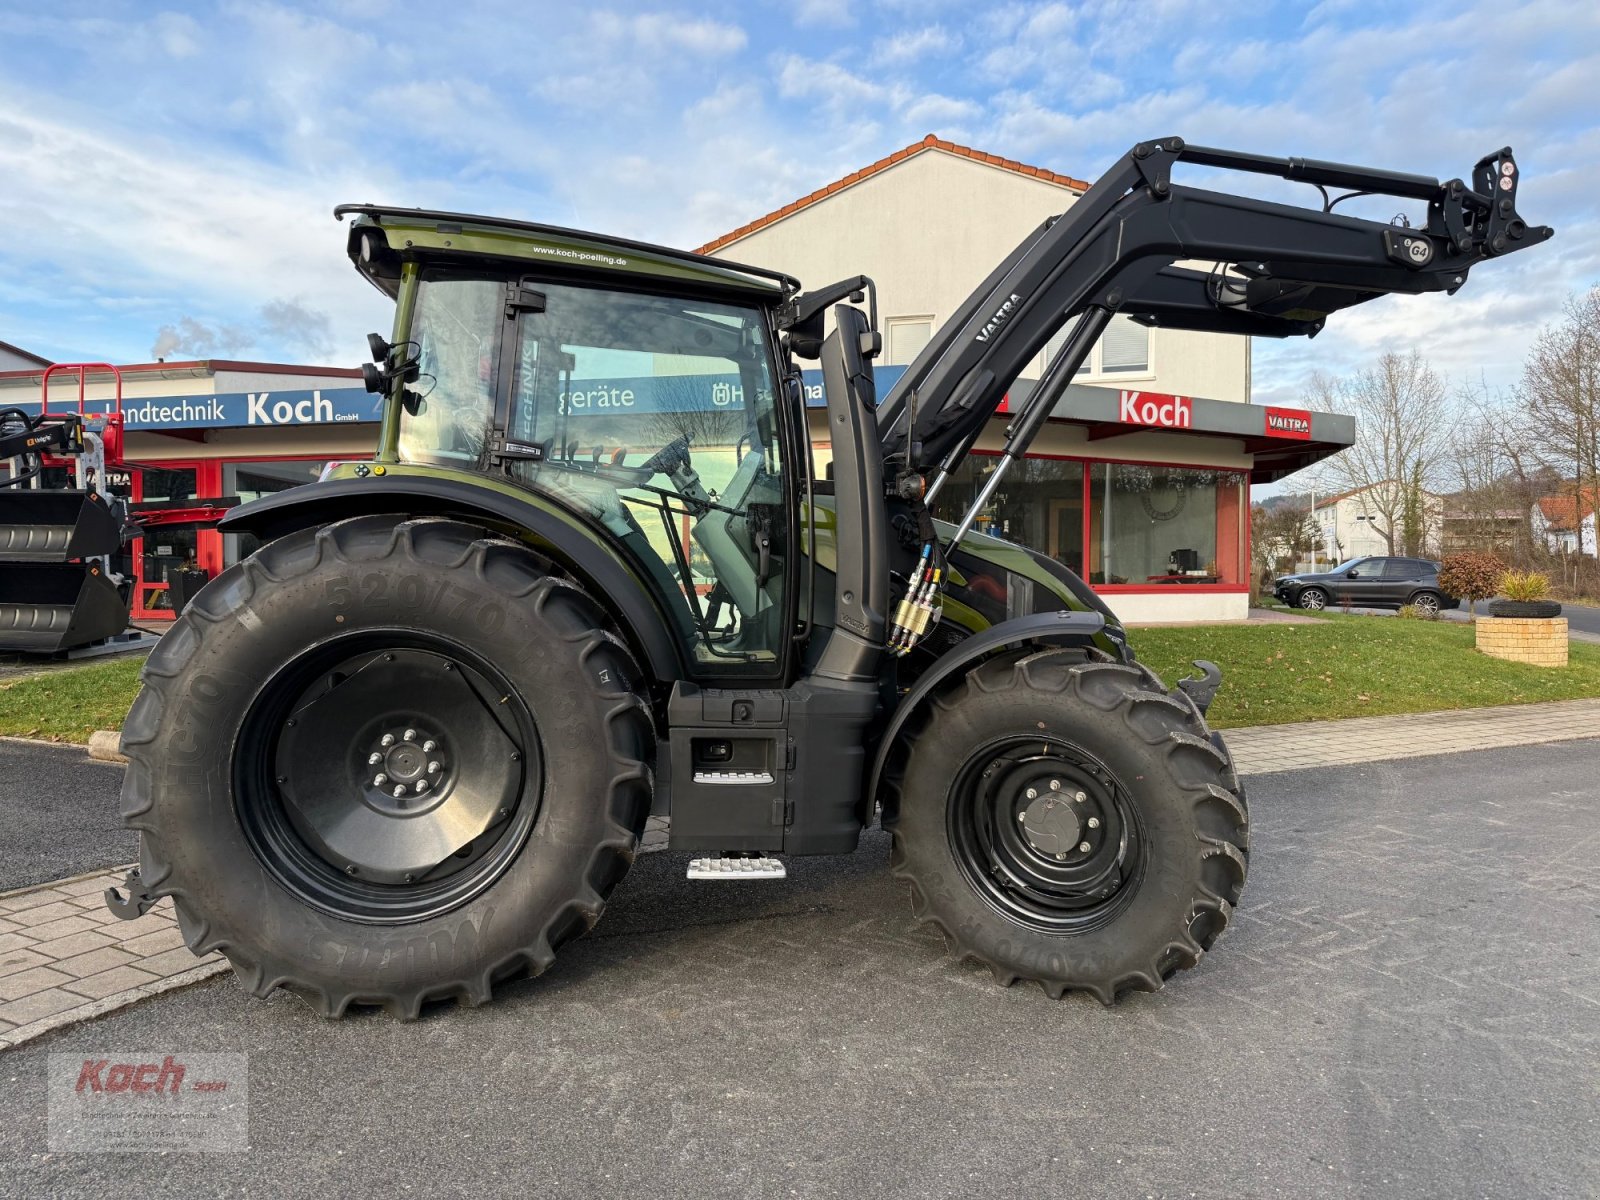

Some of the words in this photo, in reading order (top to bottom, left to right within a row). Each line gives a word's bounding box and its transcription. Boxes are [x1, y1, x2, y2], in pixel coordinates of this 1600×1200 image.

[1411, 245, 1427, 257] G4
[975, 293, 1021, 342] VALTRA
[247, 390, 334, 425] Koch
[335, 413, 359, 421] GmbH
[1121, 390, 1189, 427] Koch
[1268, 415, 1309, 433] VALTRA
[86, 473, 131, 486] ATRA
